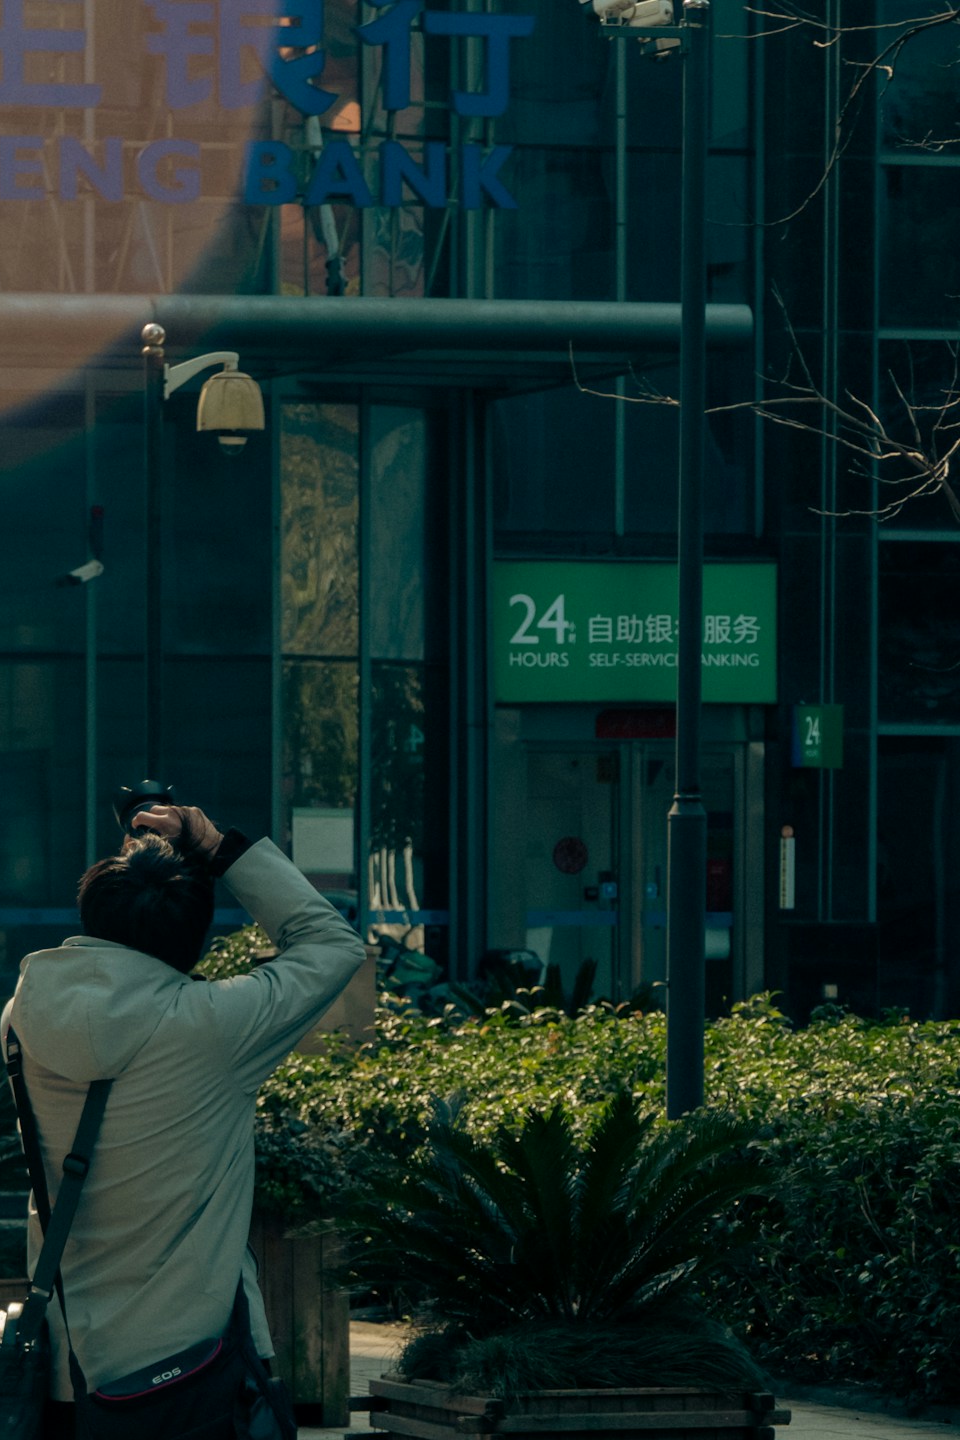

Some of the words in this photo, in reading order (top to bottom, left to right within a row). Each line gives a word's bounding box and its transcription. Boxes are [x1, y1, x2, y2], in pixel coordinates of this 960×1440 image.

[245, 140, 518, 209] BANK
[508, 593, 570, 645] 24
[588, 614, 761, 645] 自助银服务
[508, 651, 570, 667] HOURS
[589, 652, 678, 667] SELF-SERVIC
[700, 652, 760, 667] ANKING
[805, 715, 820, 746] 24
[152, 1366, 182, 1385] EOS
